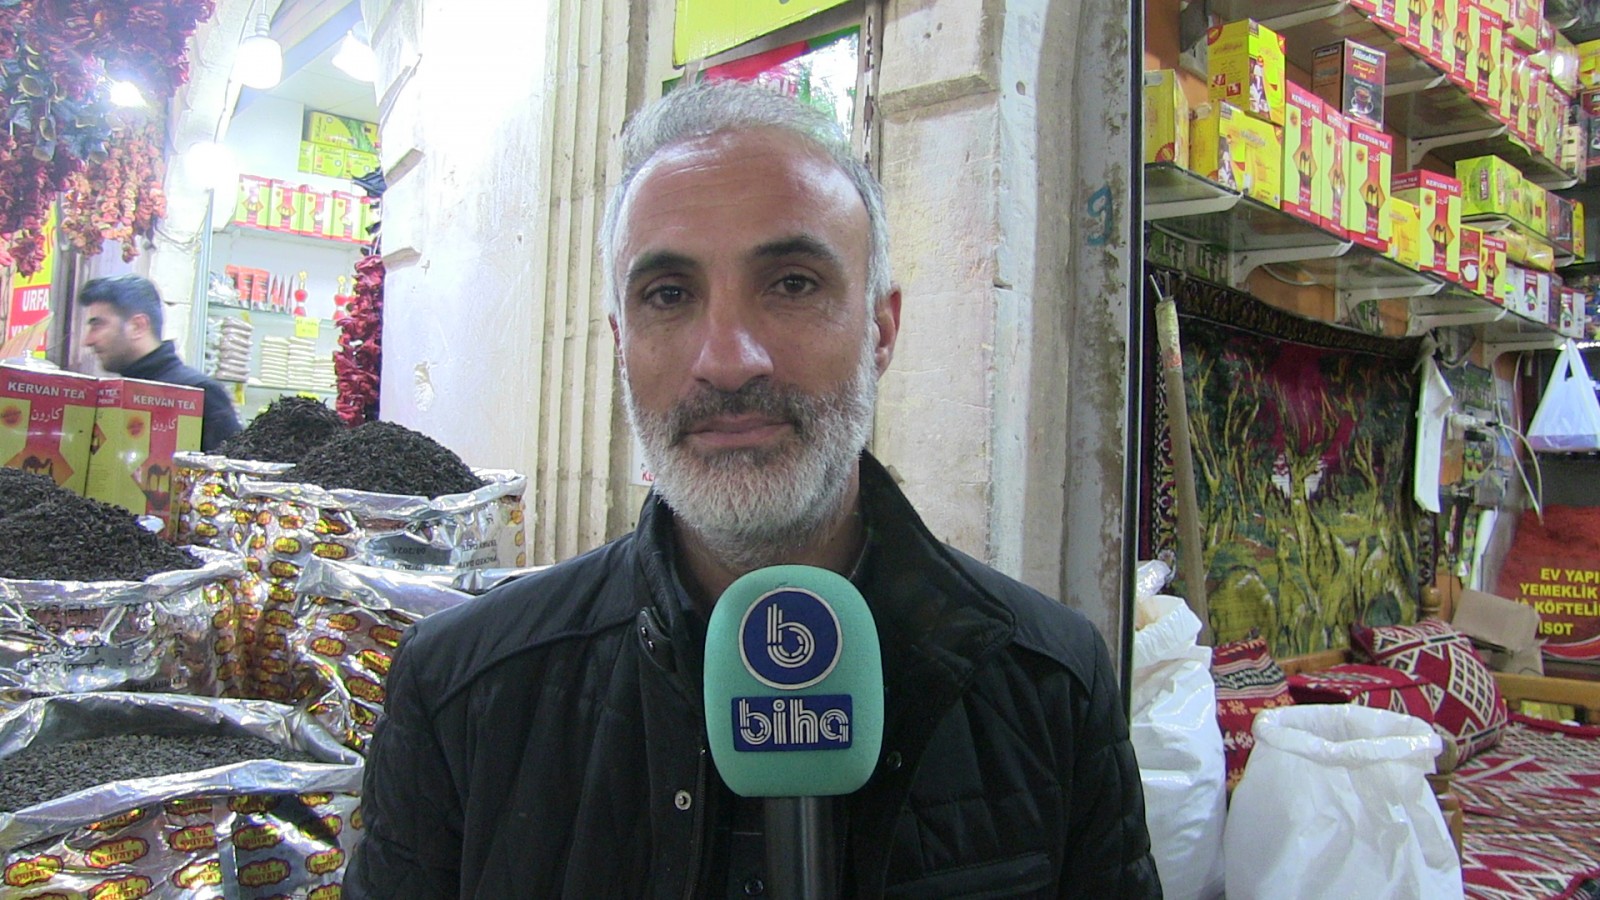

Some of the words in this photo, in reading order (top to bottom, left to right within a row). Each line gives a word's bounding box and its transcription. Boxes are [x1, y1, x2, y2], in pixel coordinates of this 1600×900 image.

[1425, 178, 1448, 190] KERVAN
[22, 288, 50, 312] URFA
[8, 381, 59, 397] KERVAN
[63, 388, 86, 400] TEA
[133, 394, 175, 408] KERVAN
[178, 400, 196, 410] TEA
[1541, 568, 1561, 581] EV
[1565, 569, 1600, 584] YAPI
[1520, 583, 1599, 600] YEMEKLİK
[1534, 599, 1600, 617] KÖFTELİ
[767, 603, 815, 668] b
[739, 698, 849, 745] biha
